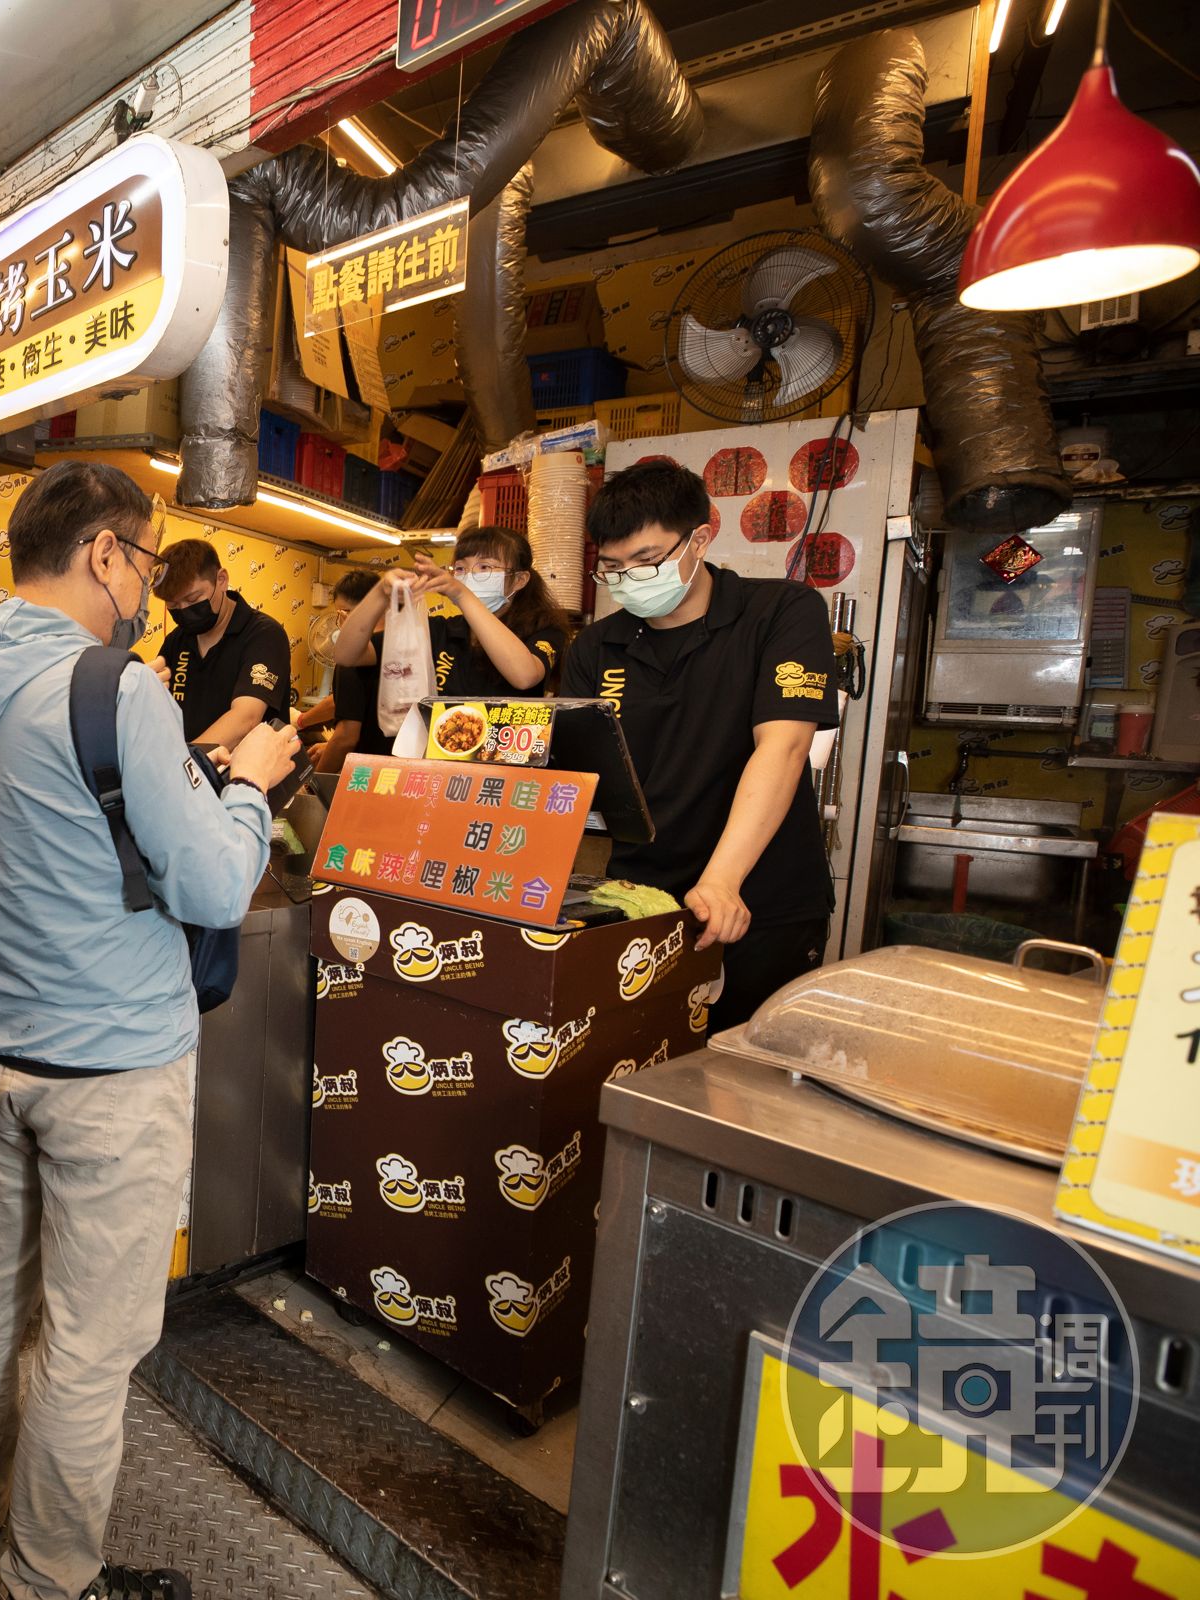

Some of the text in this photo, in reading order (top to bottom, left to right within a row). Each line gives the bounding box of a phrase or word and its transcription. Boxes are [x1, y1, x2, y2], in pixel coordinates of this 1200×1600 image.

[312, 224, 460, 315] 點餐請往前
[172, 651, 190, 701] UNCLE
[600, 668, 625, 719] UNC
